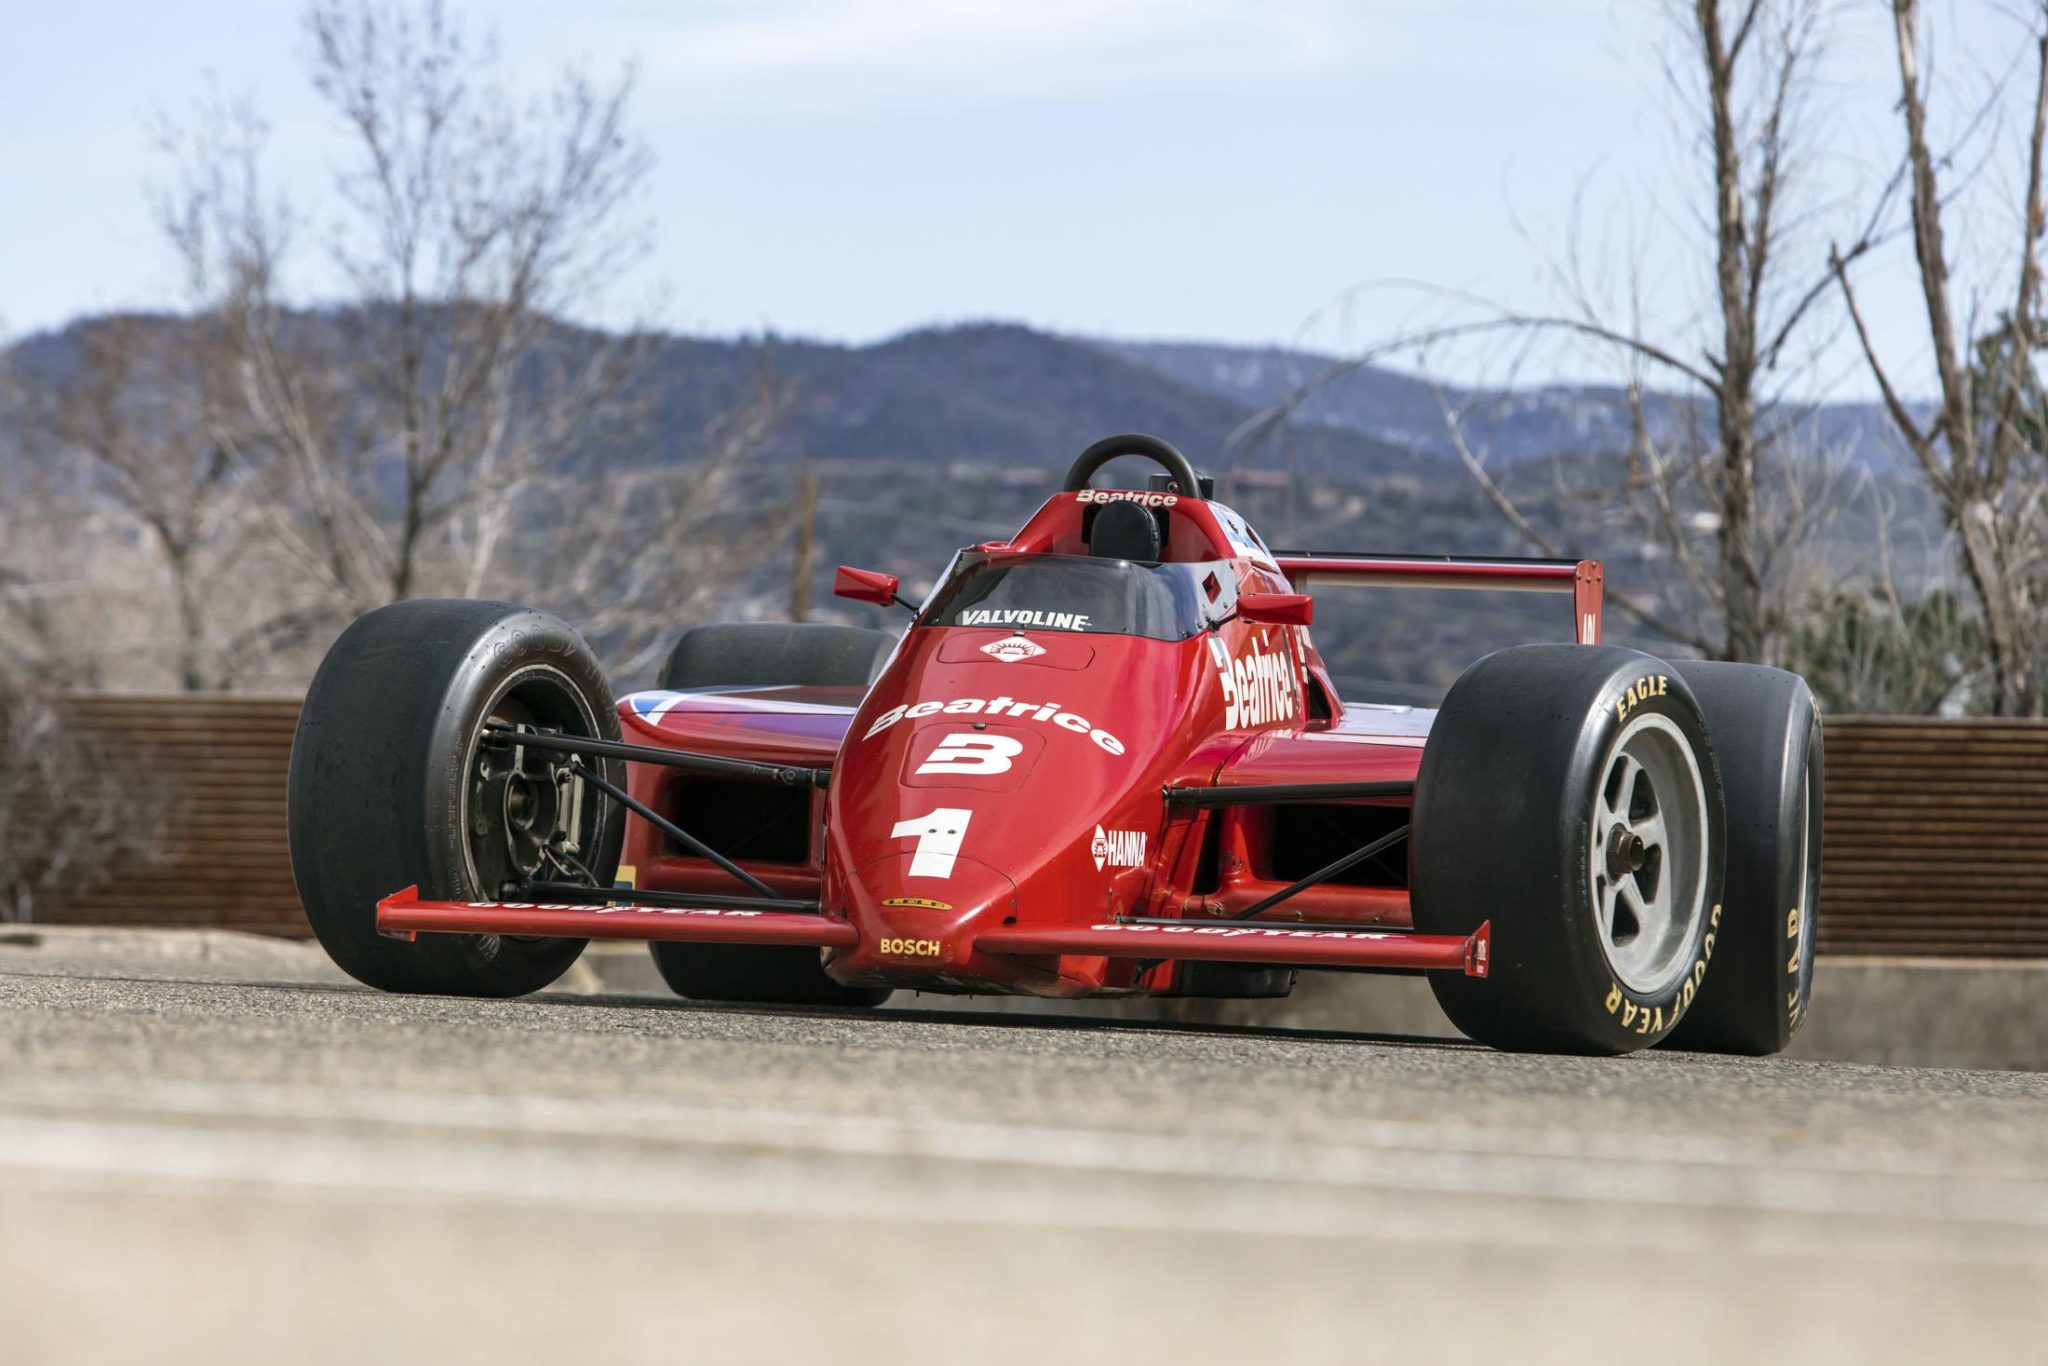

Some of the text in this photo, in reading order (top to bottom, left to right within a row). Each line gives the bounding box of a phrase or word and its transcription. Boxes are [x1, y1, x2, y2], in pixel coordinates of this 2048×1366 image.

[1076, 489, 1178, 507] Beatrice
[962, 610, 1089, 631] VALVOLINE
[1208, 629, 1293, 731] Beatrice
[1616, 675, 1667, 723] EAGLE
[862, 696, 1125, 756] Beatrice
[914, 733, 1023, 774] B
[890, 808, 972, 879] 1
[1107, 830, 1146, 867] HANNA
[880, 938, 940, 956] BOSCH
[1091, 924, 1389, 939] GOODYEAR
